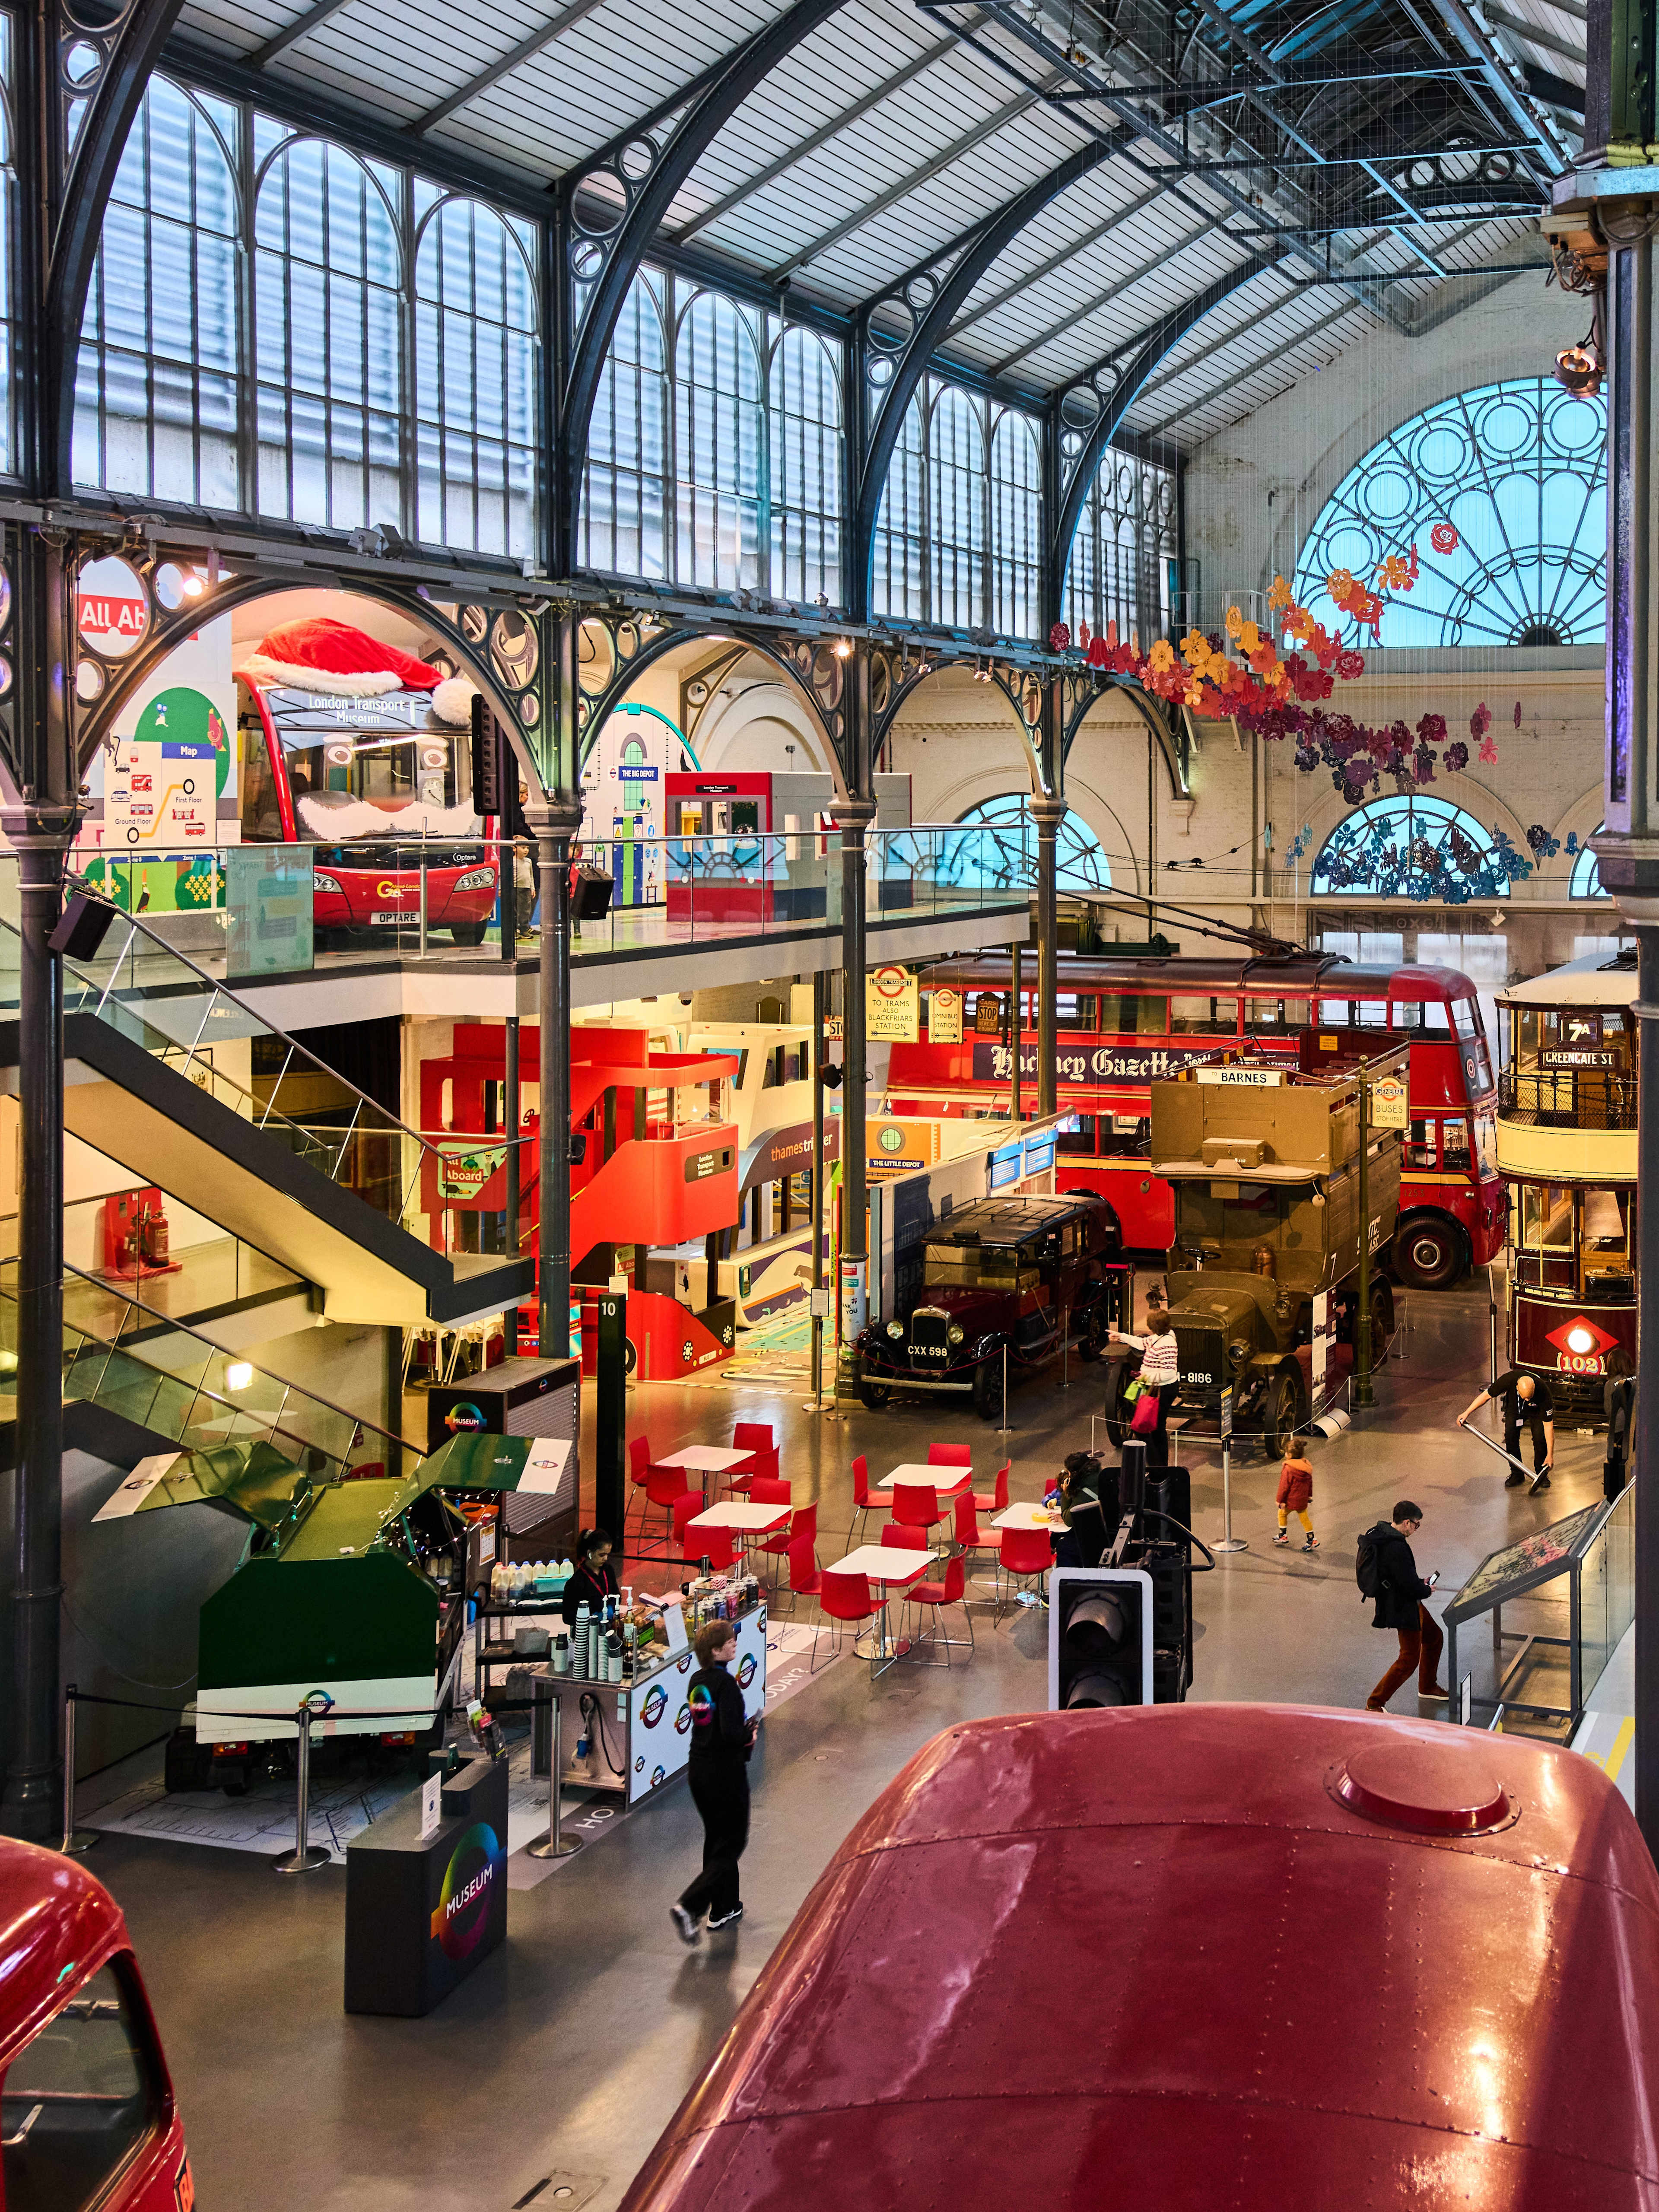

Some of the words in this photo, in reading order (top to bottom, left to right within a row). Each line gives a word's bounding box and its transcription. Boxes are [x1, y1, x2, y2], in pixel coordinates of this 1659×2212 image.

[80, 601, 111, 627] All
[309, 694, 348, 709] London
[352, 696, 405, 714] Transport
[337, 711, 380, 724] Museum
[180, 746, 197, 758] Map
[380, 913, 416, 923] OPTARE
[979, 1006, 997, 1020] STOP
[1545, 1052, 1597, 1065] GREENGATE
[1221, 1072, 1267, 1084] BARNES
[1376, 1105, 1403, 1113] BUSES
[771, 1134, 833, 1161] thamestrier
[447, 1170, 482, 1181] Aboard
[602, 1302, 616, 1316] 10
[908, 1346, 926, 1355] CXX
[929, 1347, 947, 1357] 598
[1562, 1356, 1599, 1373] 102
[740, 1665, 753, 1677] MUSEUM
[645, 1699, 663, 1715] MUSEUM
[447, 1863, 492, 1919] MUSEUM
